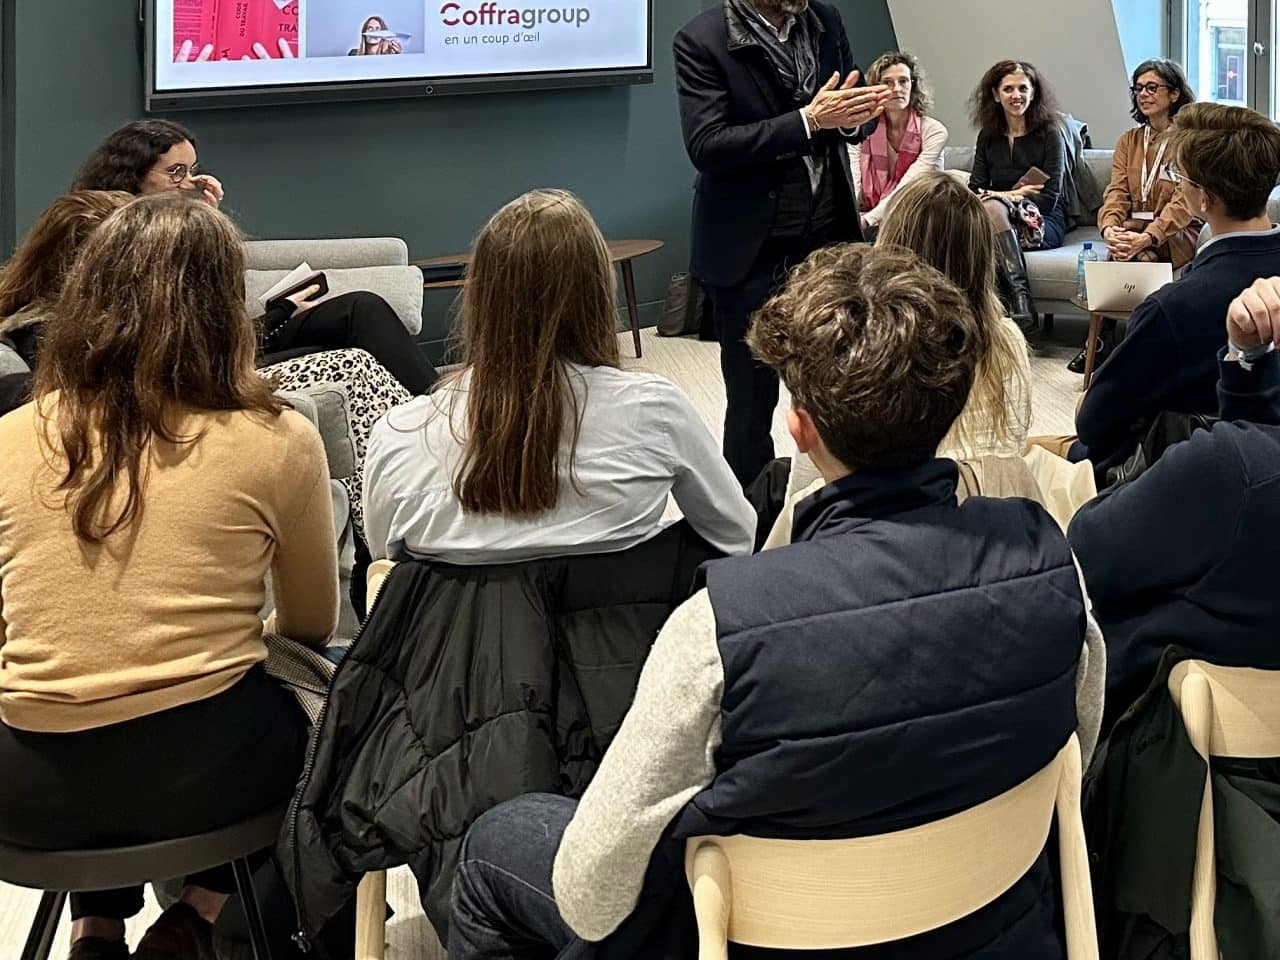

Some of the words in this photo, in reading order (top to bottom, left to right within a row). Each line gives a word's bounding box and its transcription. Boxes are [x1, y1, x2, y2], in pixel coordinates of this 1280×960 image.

[440, 2, 590, 29] Coffragroup
[445, 36, 458, 44] en
[463, 35, 477, 44] un
[482, 34, 509, 45] coup
[513, 32, 540, 42] d'œil
